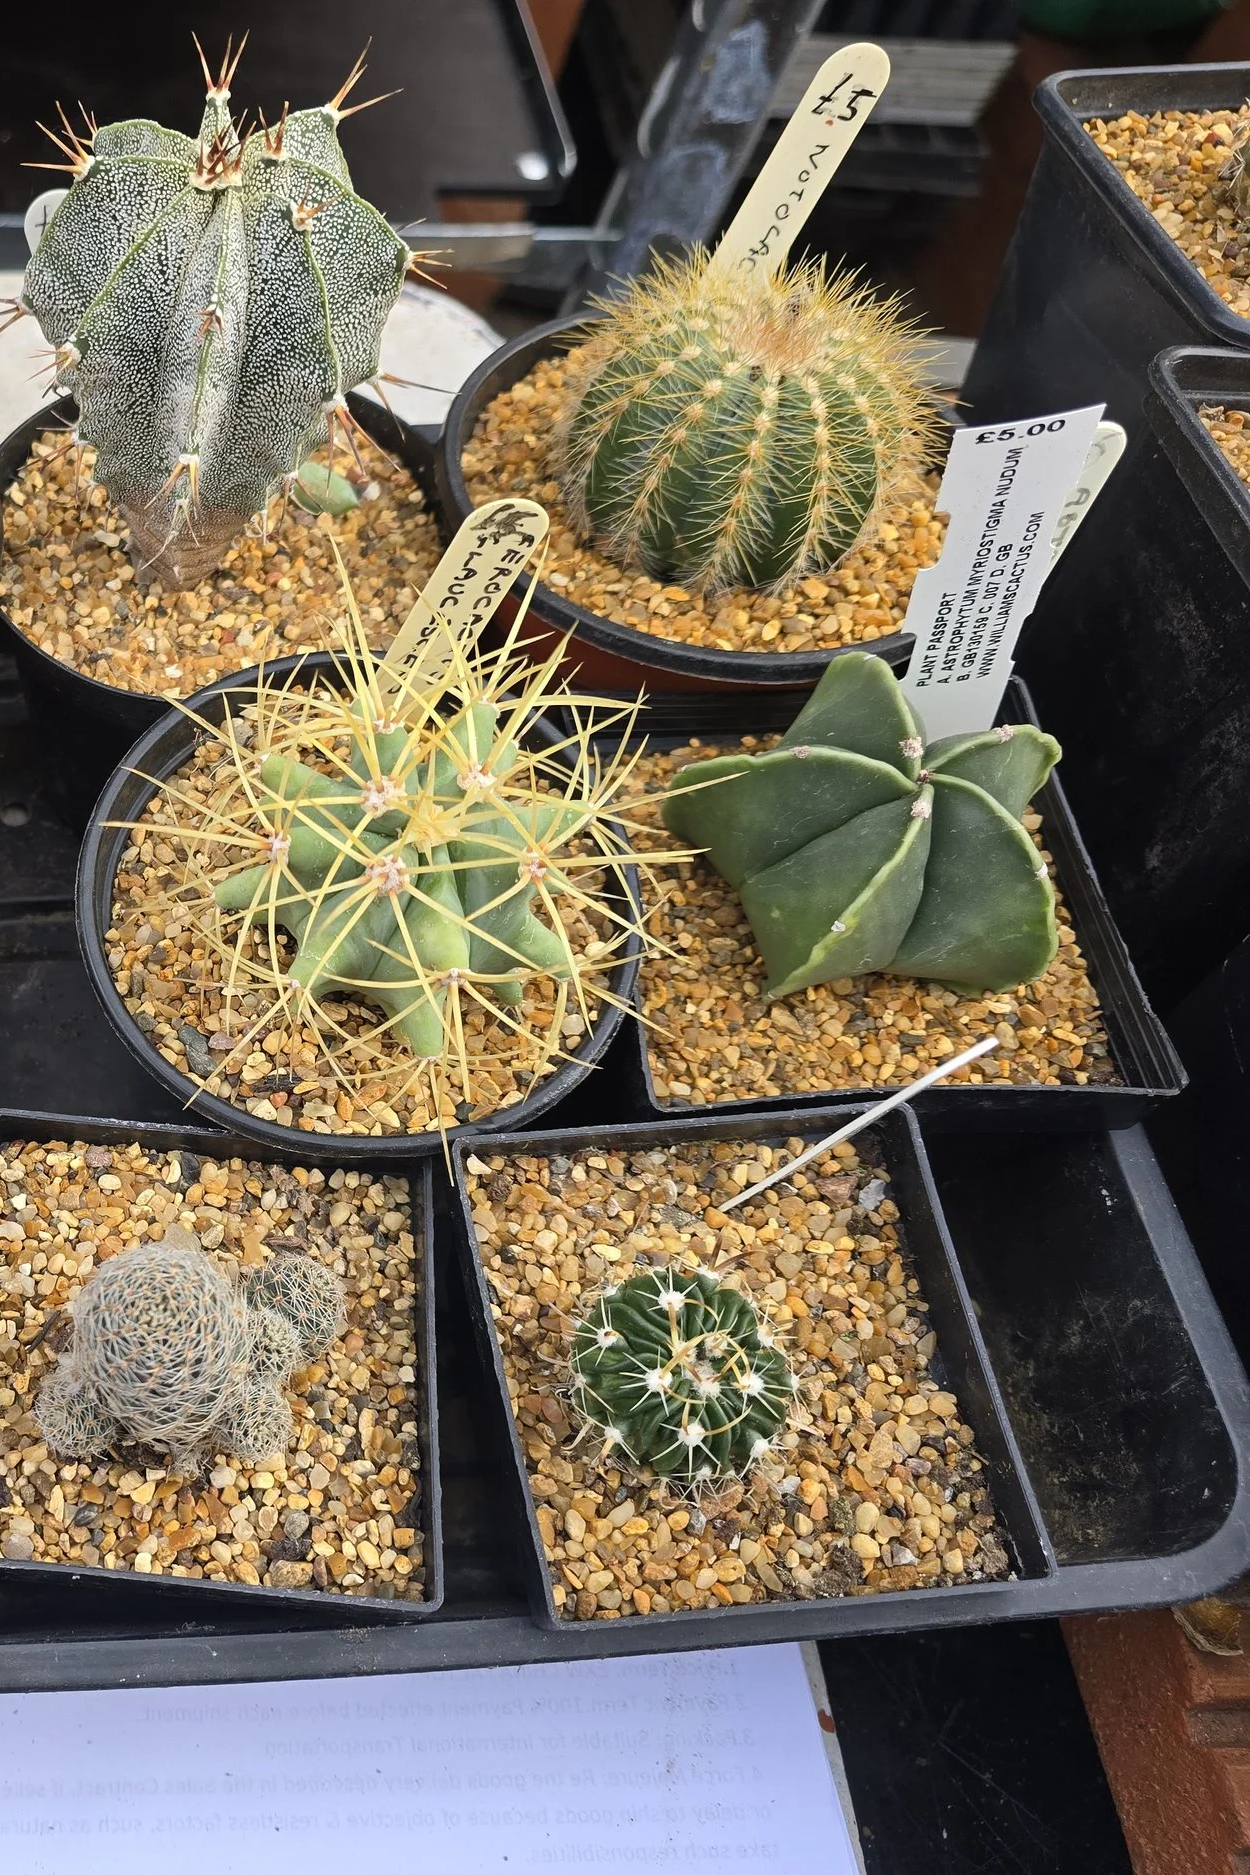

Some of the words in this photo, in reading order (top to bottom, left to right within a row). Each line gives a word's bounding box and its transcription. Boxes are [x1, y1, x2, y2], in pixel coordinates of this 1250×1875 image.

[811, 73, 877, 121] £5
[975, 419, 1066, 444] £5.00
[995, 447, 1024, 497] NUDUM
[967, 499, 1008, 586] MYRIOSTIGMA
[996, 543, 1013, 561] GB
[990, 565, 1007, 578] D.
[976, 511, 1045, 678] WWW.WILLIAMSCACTUS.COM
[979, 602, 994, 614] C.
[983, 582, 1001, 600] 007
[916, 655, 937, 687] PLANT
[927, 592, 957, 651] PASSPORT
[941, 590, 979, 671] ASTROPHYTUM
[962, 617, 989, 668] GB130159
[937, 674, 952, 683] A.
[956, 671, 972, 682] B.
